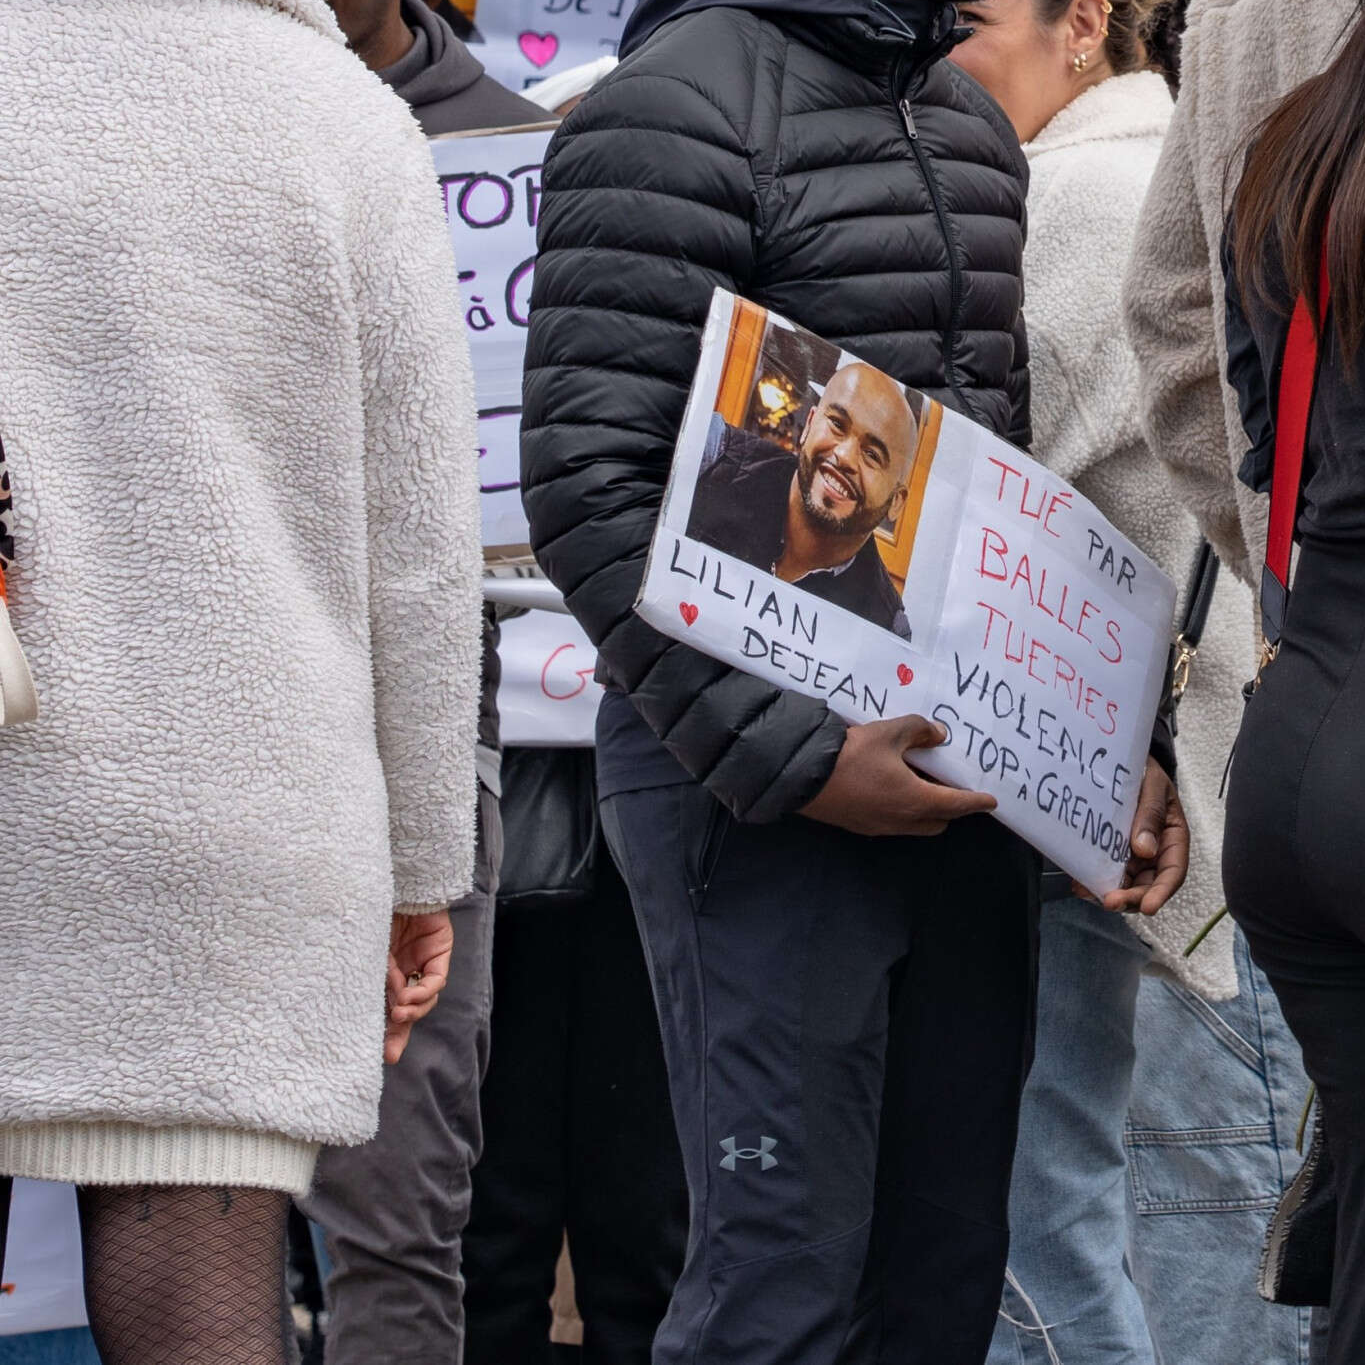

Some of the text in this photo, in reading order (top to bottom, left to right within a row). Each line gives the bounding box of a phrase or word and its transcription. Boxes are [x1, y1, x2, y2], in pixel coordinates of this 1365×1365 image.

[669, 539, 818, 646] LILIAN
[987, 456, 1137, 595] TUÉ PAR
[976, 526, 1125, 665] BALLES
[739, 625, 889, 719] DEJEAN
[953, 651, 1132, 807] VIOLENCE
[975, 600, 1118, 736] TUERIES
[930, 702, 1021, 783] STOP
